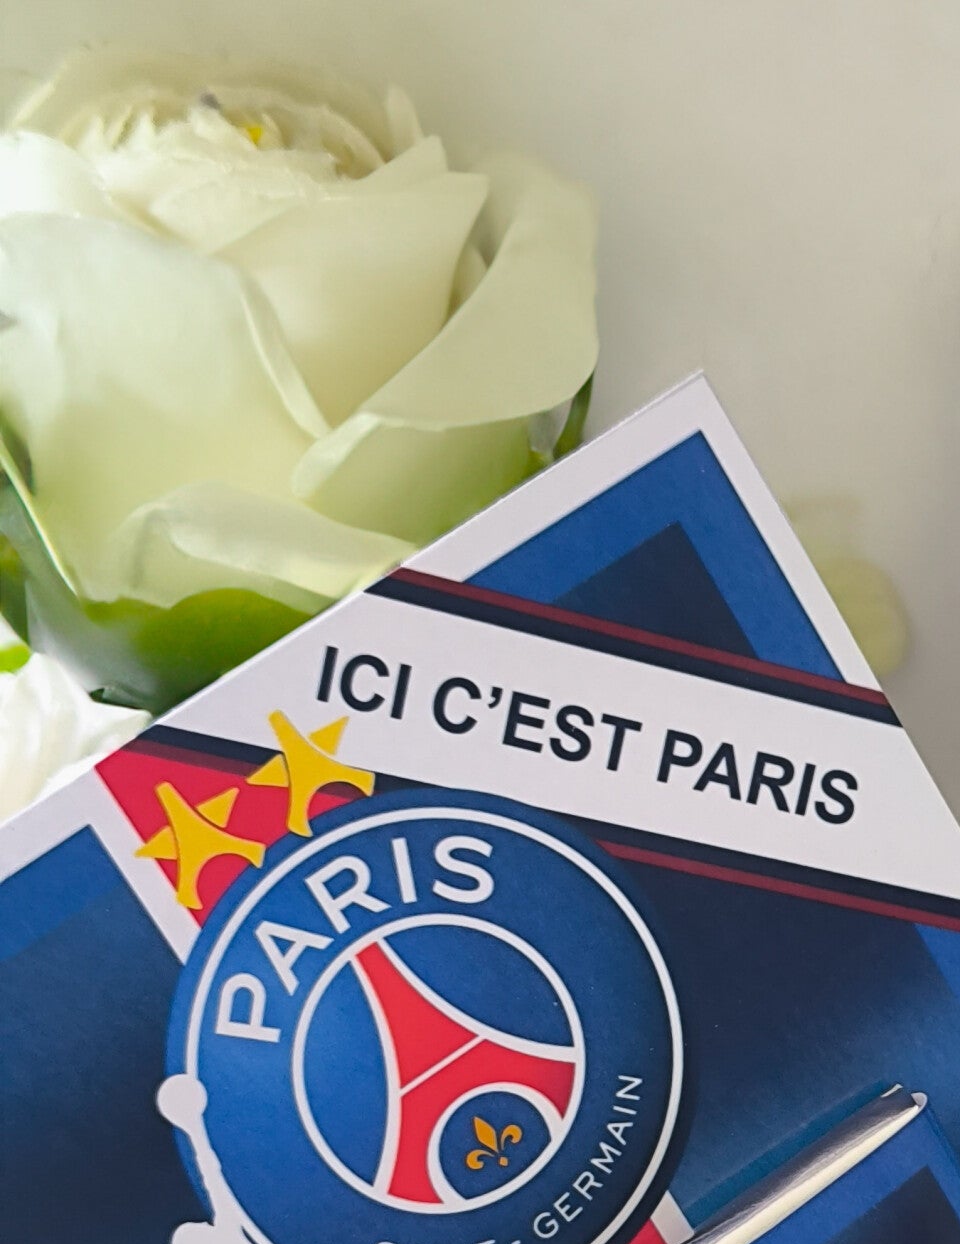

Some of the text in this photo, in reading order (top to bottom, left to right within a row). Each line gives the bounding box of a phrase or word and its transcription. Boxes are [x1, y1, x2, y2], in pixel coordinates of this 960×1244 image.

[316, 645, 412, 720] ICI
[656, 729, 860, 825] PARIS
[215, 835, 495, 1043] PARIS
[532, 1075, 644, 1240] GERMAIN
